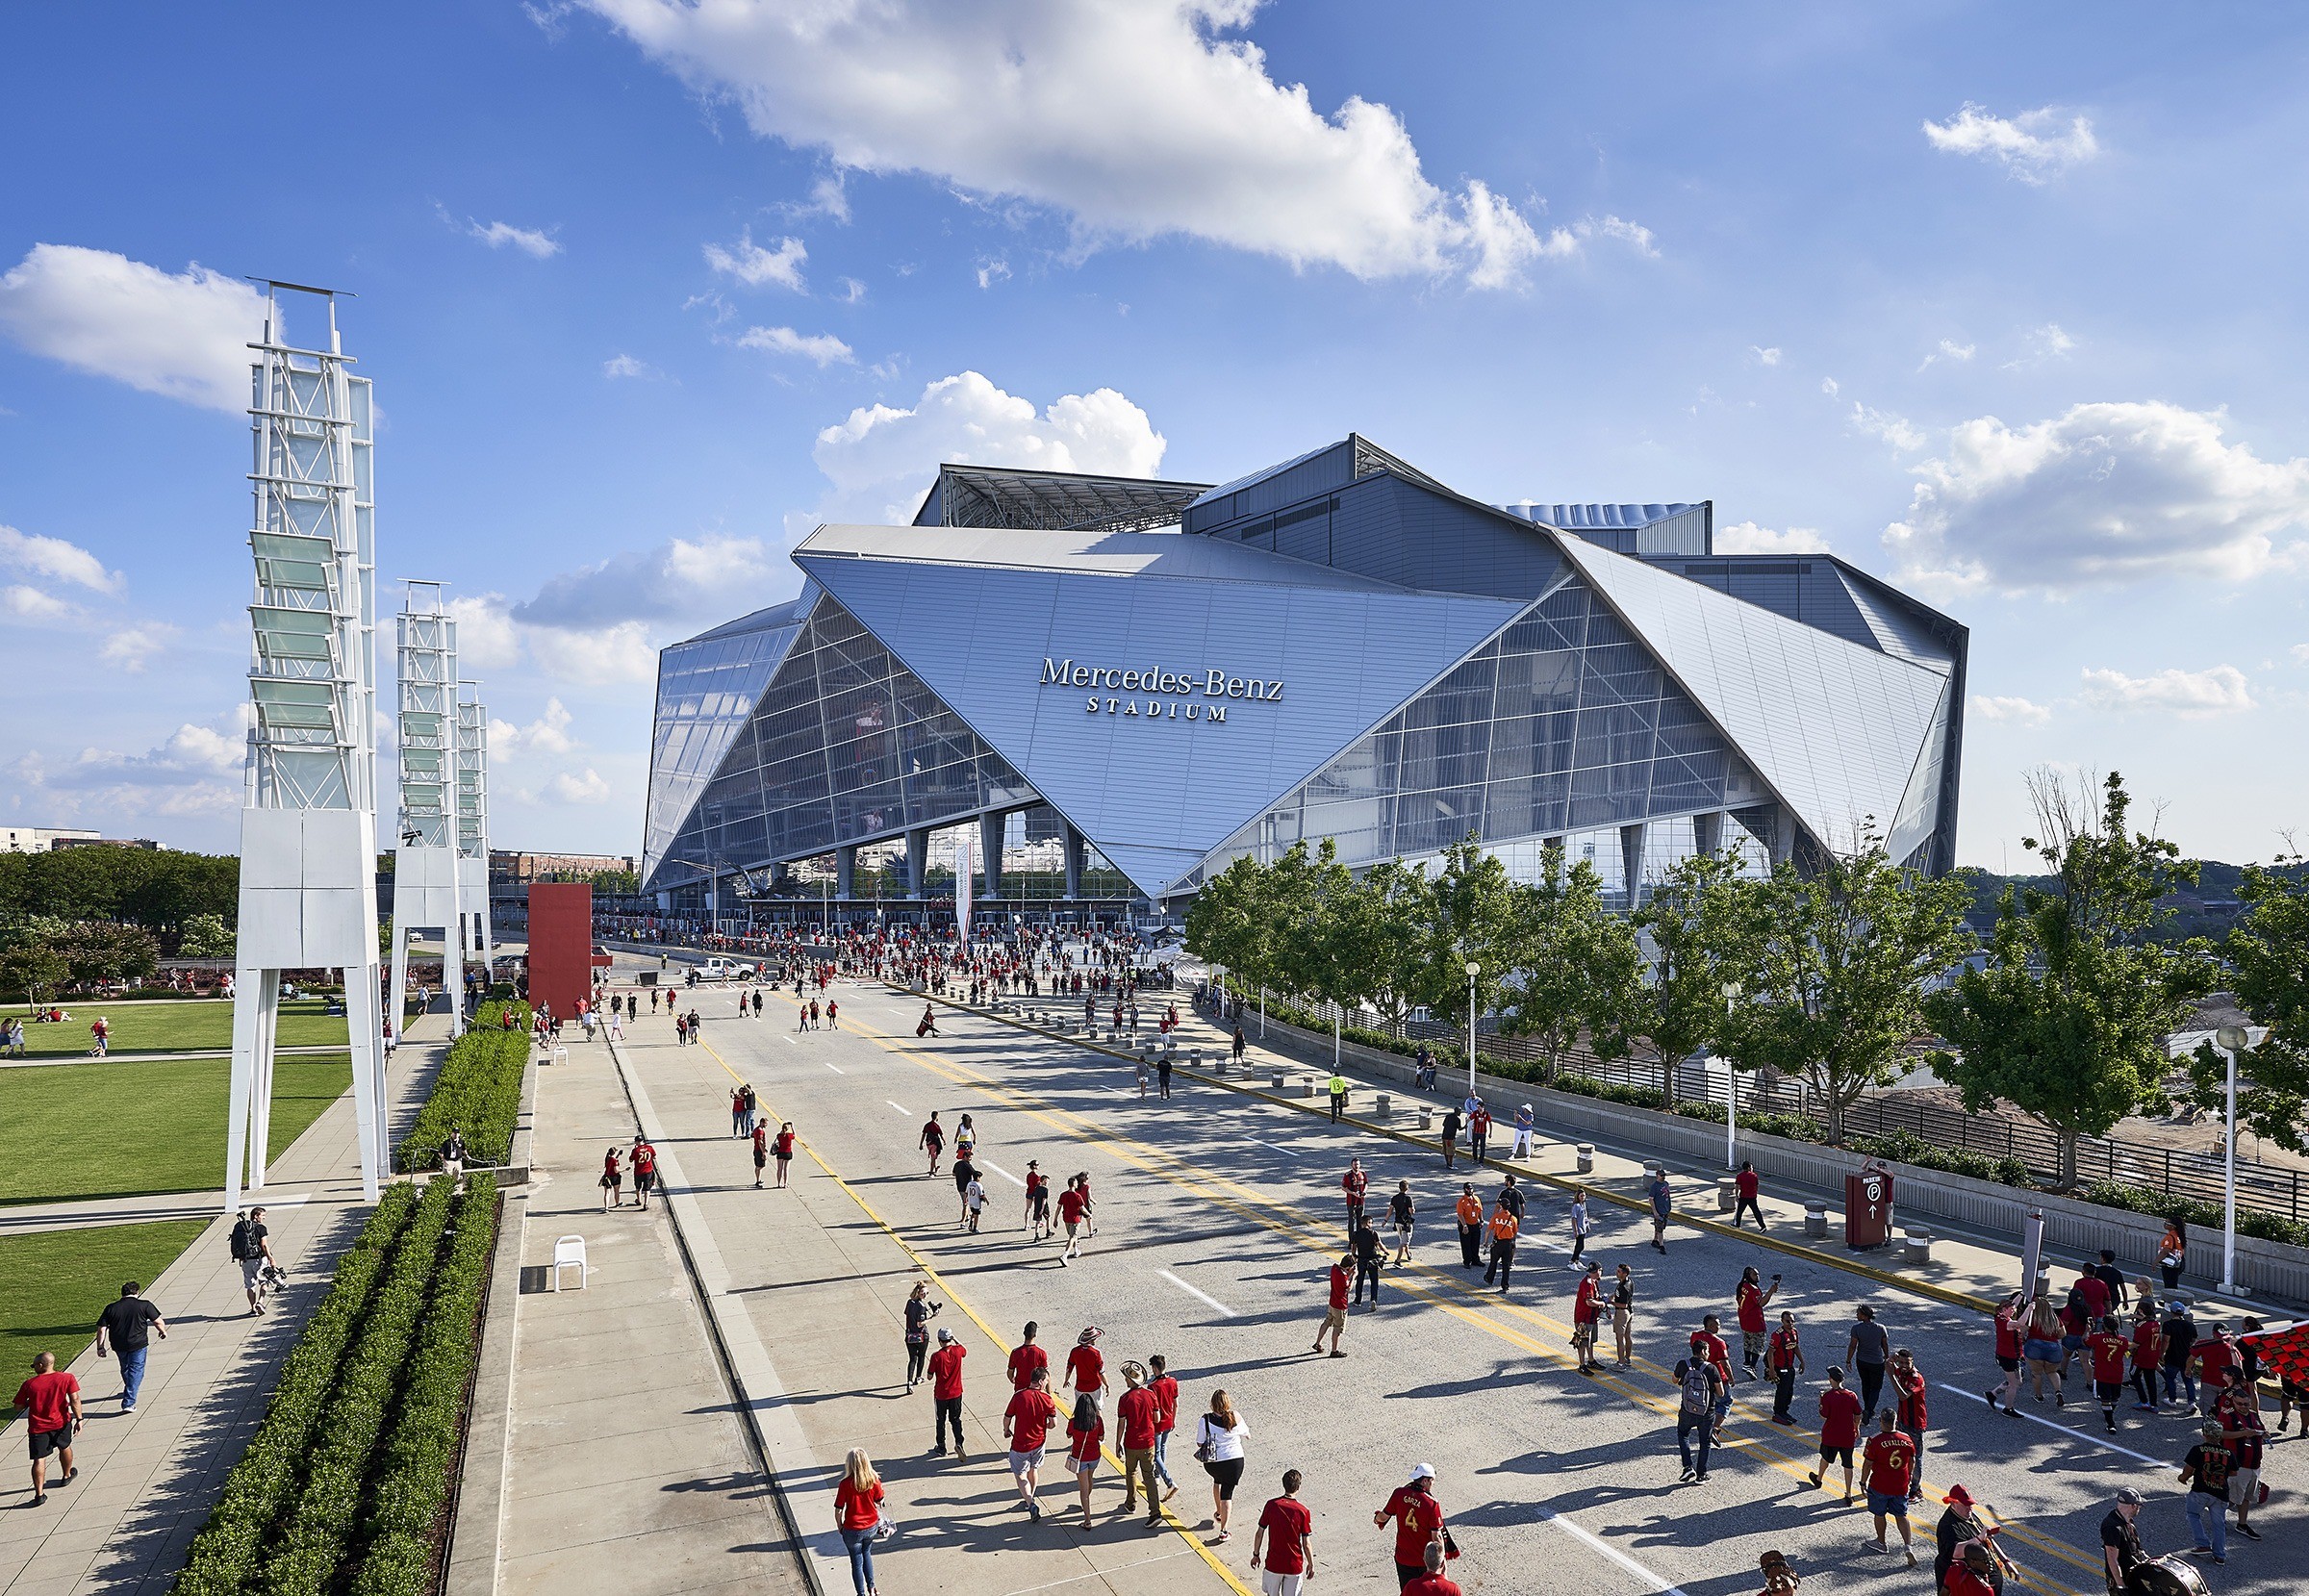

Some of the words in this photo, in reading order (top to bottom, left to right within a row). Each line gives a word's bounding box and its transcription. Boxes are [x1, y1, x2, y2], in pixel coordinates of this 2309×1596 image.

[1039, 657, 1284, 701] Mercedes-Benz
[1086, 697, 1228, 722] STADIUM
[930, 899, 955, 908] GATE
[638, 1151, 651, 1163] 20
[969, 1187, 977, 1197] 10
[2150, 1333, 2160, 1351] 17
[2108, 1344, 2118, 1361] 7
[1890, 1449, 1903, 1470] 6
[1403, 1495, 1421, 1507] GARZA
[1405, 1507, 1419, 1533] 4
